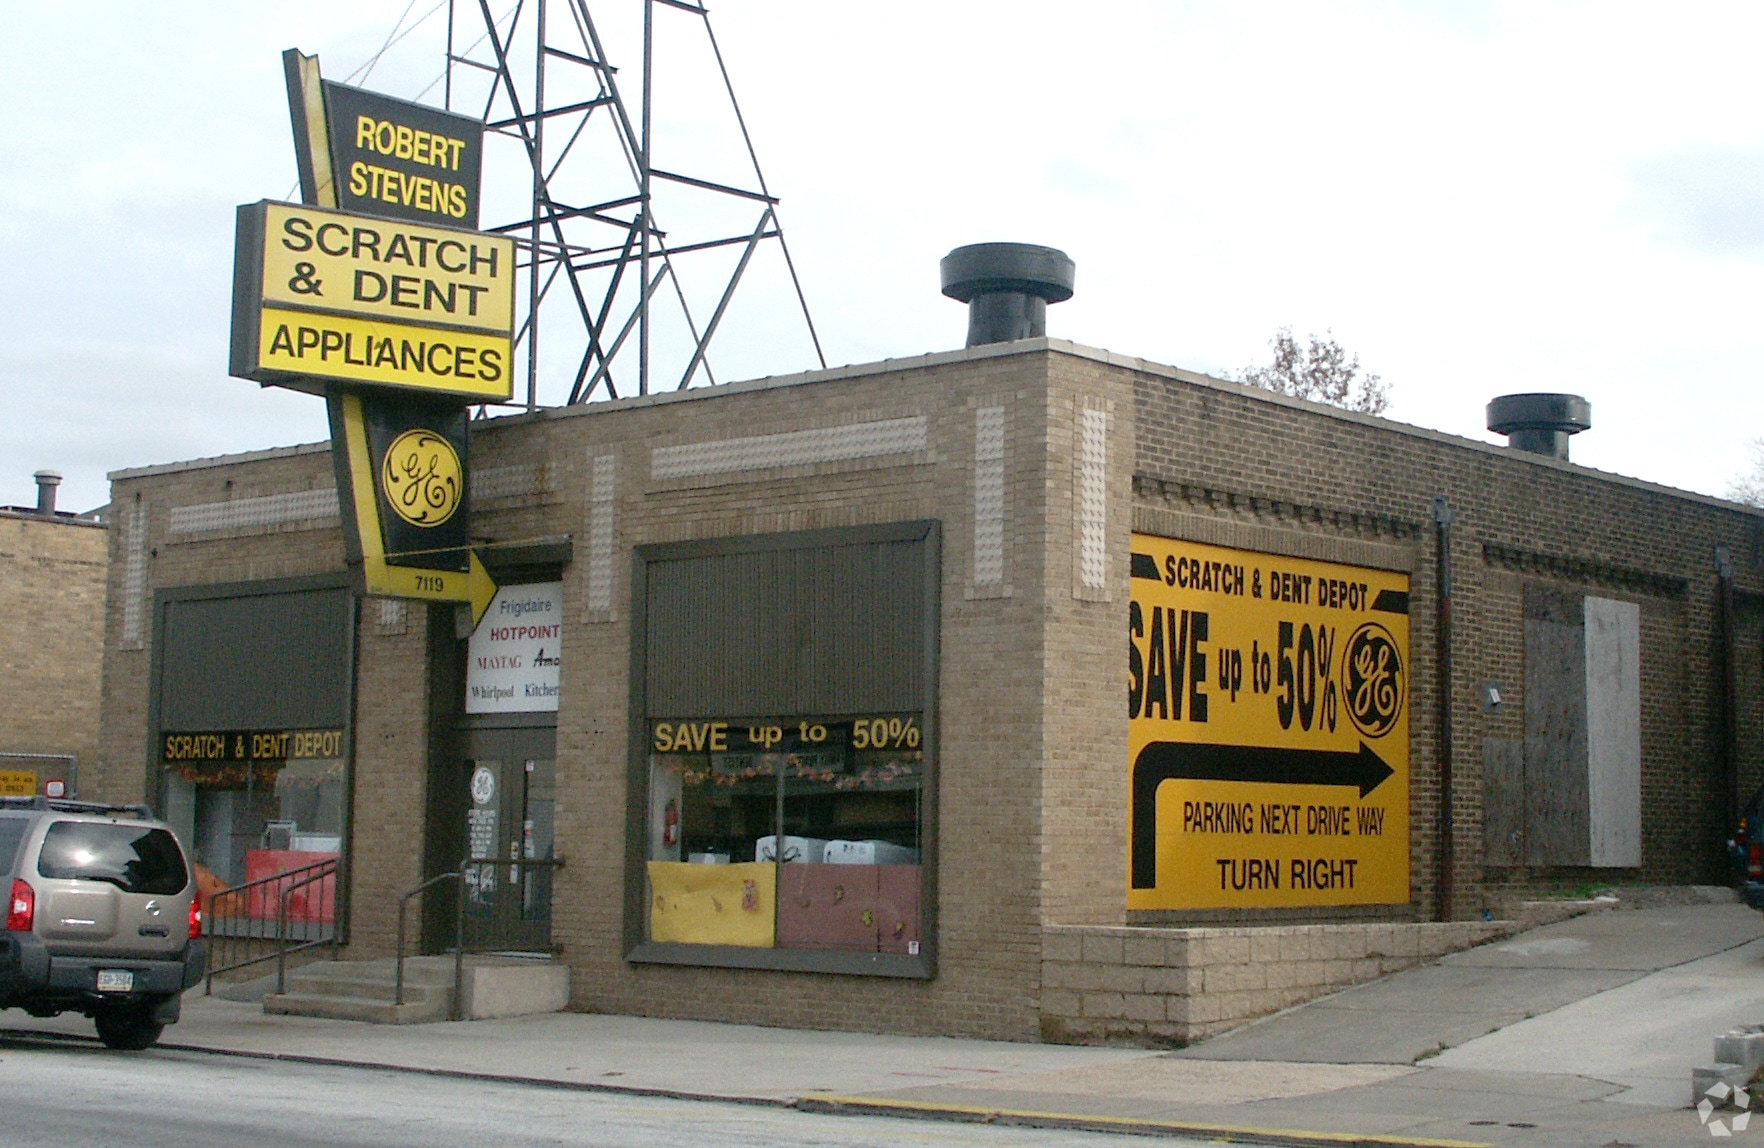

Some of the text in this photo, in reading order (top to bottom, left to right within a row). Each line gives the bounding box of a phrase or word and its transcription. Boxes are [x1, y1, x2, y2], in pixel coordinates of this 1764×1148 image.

[356, 115, 465, 171] ROBERT
[350, 161, 467, 218] STEVENS
[281, 217, 498, 278] SCRATCH
[288, 262, 488, 316] & DENT
[269, 324, 502, 382] APPLIANCES
[415, 575, 444, 592] 7119
[1165, 555, 1368, 612] SCRATCH & DENT DEPOT
[500, 601, 551, 617] Frigidaire
[491, 624, 559, 640] HOTPOINT
[478, 656, 522, 669] MAYTAG
[1128, 600, 1336, 733] SAVE up to 50%
[471, 685, 514, 702] Whirlpool
[165, 731, 341, 760] SCRATCH & DENT DEPOT
[654, 717, 921, 752] SAVE up to 50%
[1184, 801, 1385, 836] PARKING NEXT DRIVE WAY
[1217, 858, 1358, 891] TURN RIGHT
